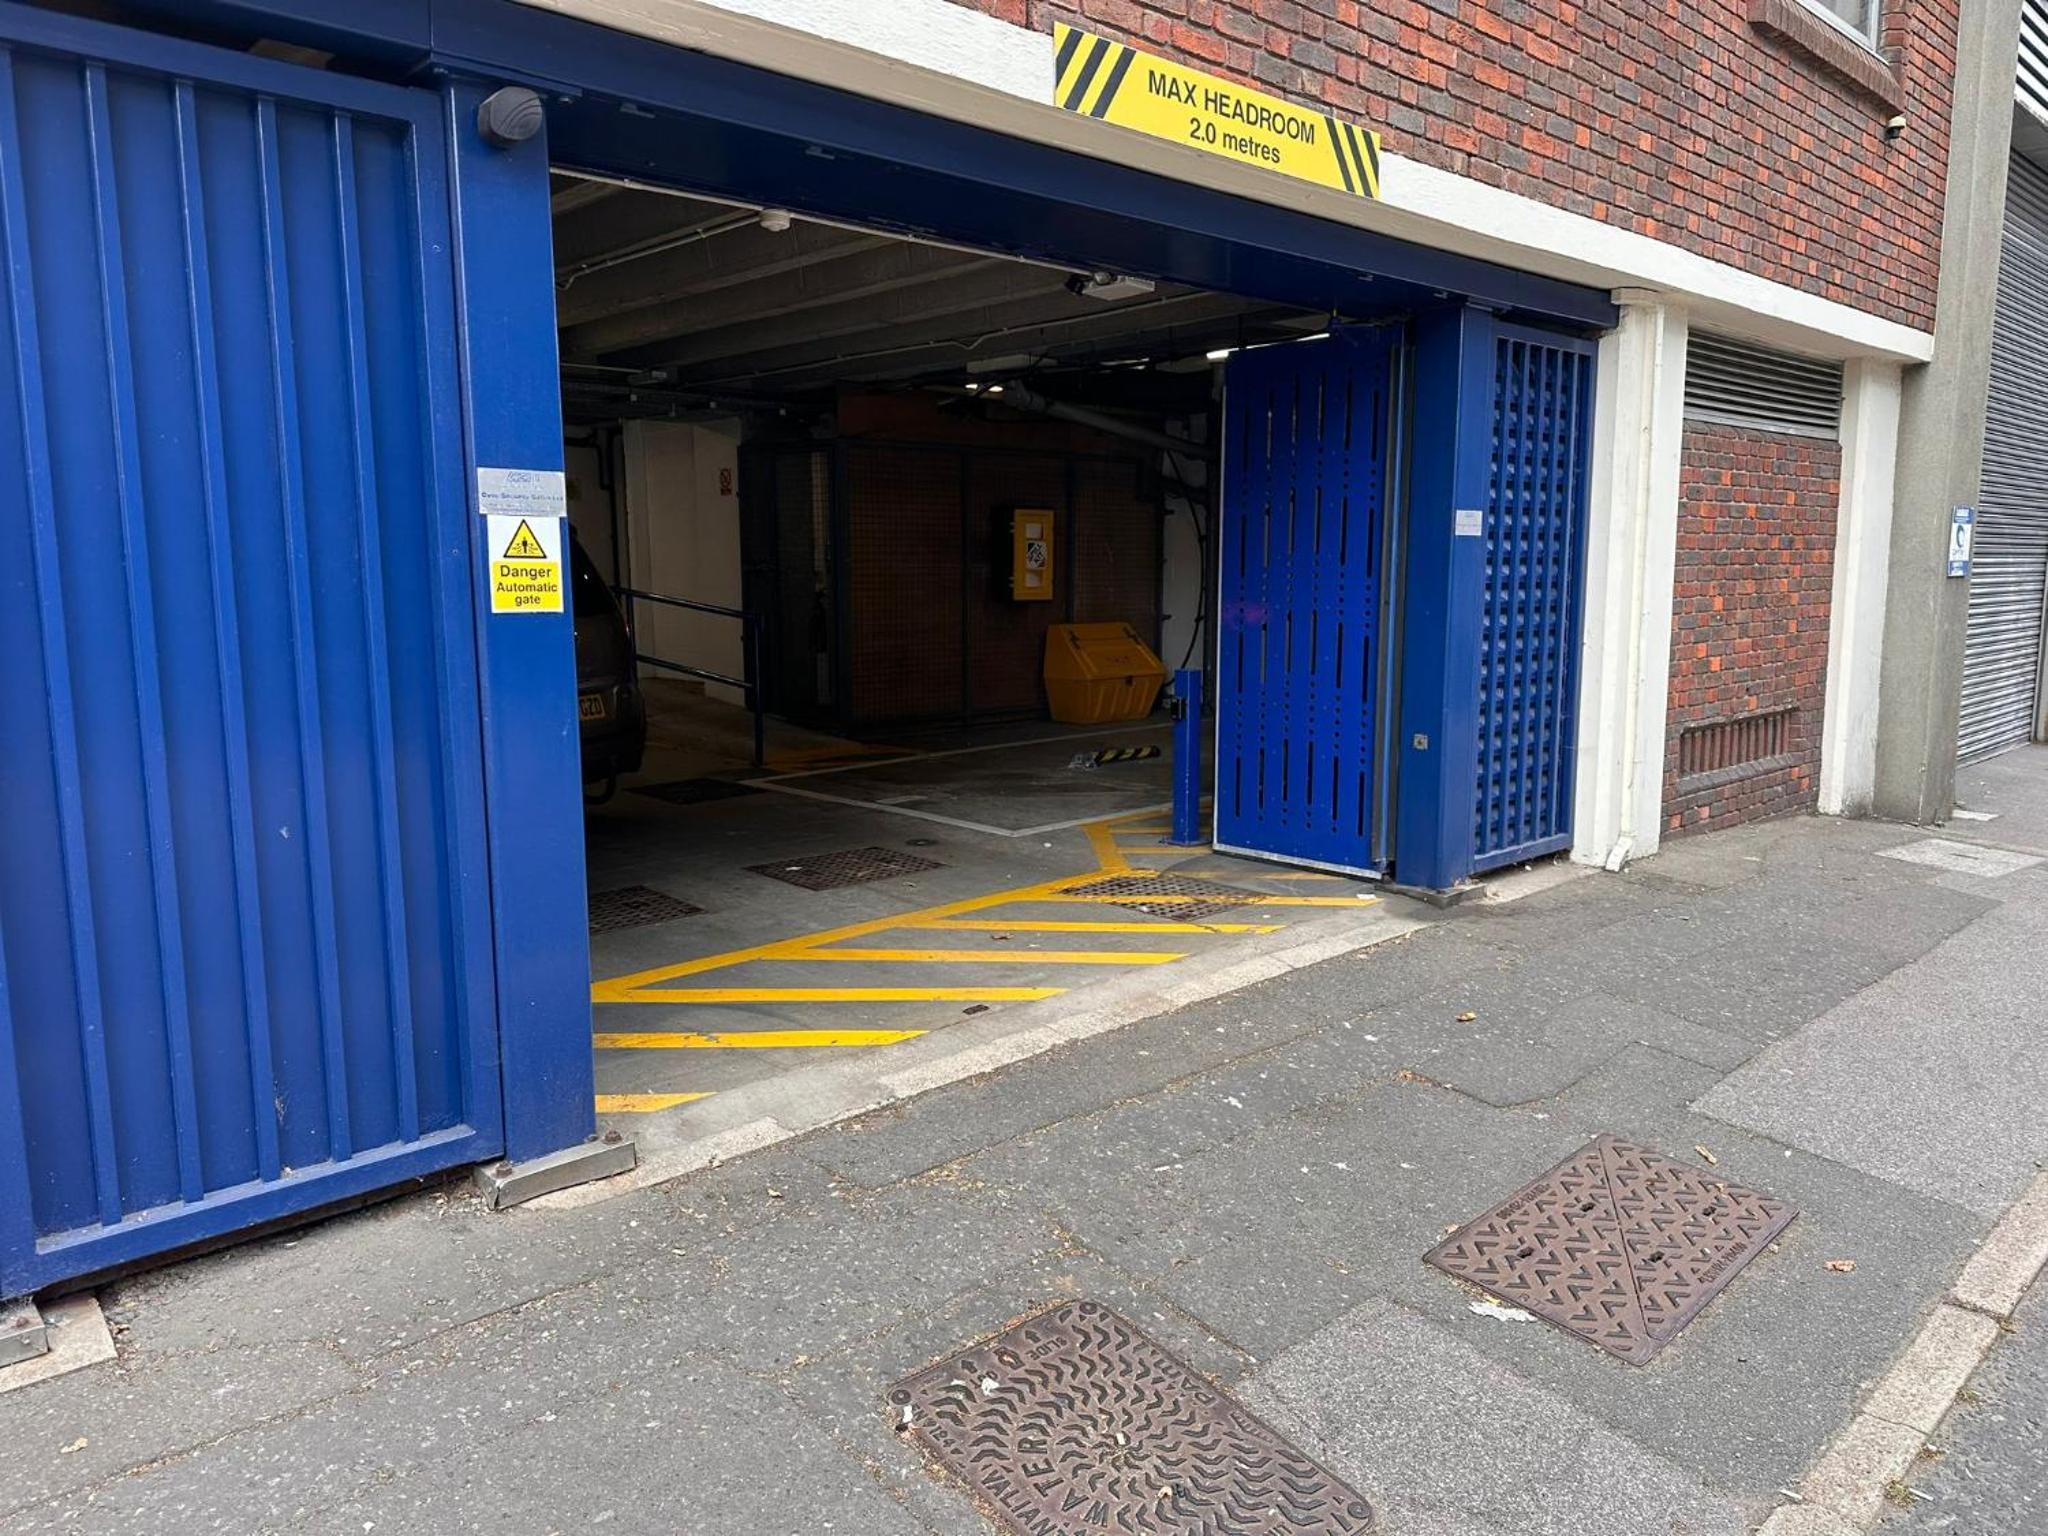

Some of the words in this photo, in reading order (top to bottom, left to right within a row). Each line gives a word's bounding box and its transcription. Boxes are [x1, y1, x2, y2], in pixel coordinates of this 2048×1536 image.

[1148, 69, 1197, 106] MAX
[1204, 89, 1315, 145] HEADROOM
[1189, 117, 1216, 144] 2.0
[1223, 131, 1281, 164] metres
[500, 565, 552, 580] Danger
[496, 582, 558, 593] Automatic
[514, 594, 541, 607] gate
[1026, 1336, 1068, 1362] SLIDE
[1018, 1436, 1109, 1528] WATER
